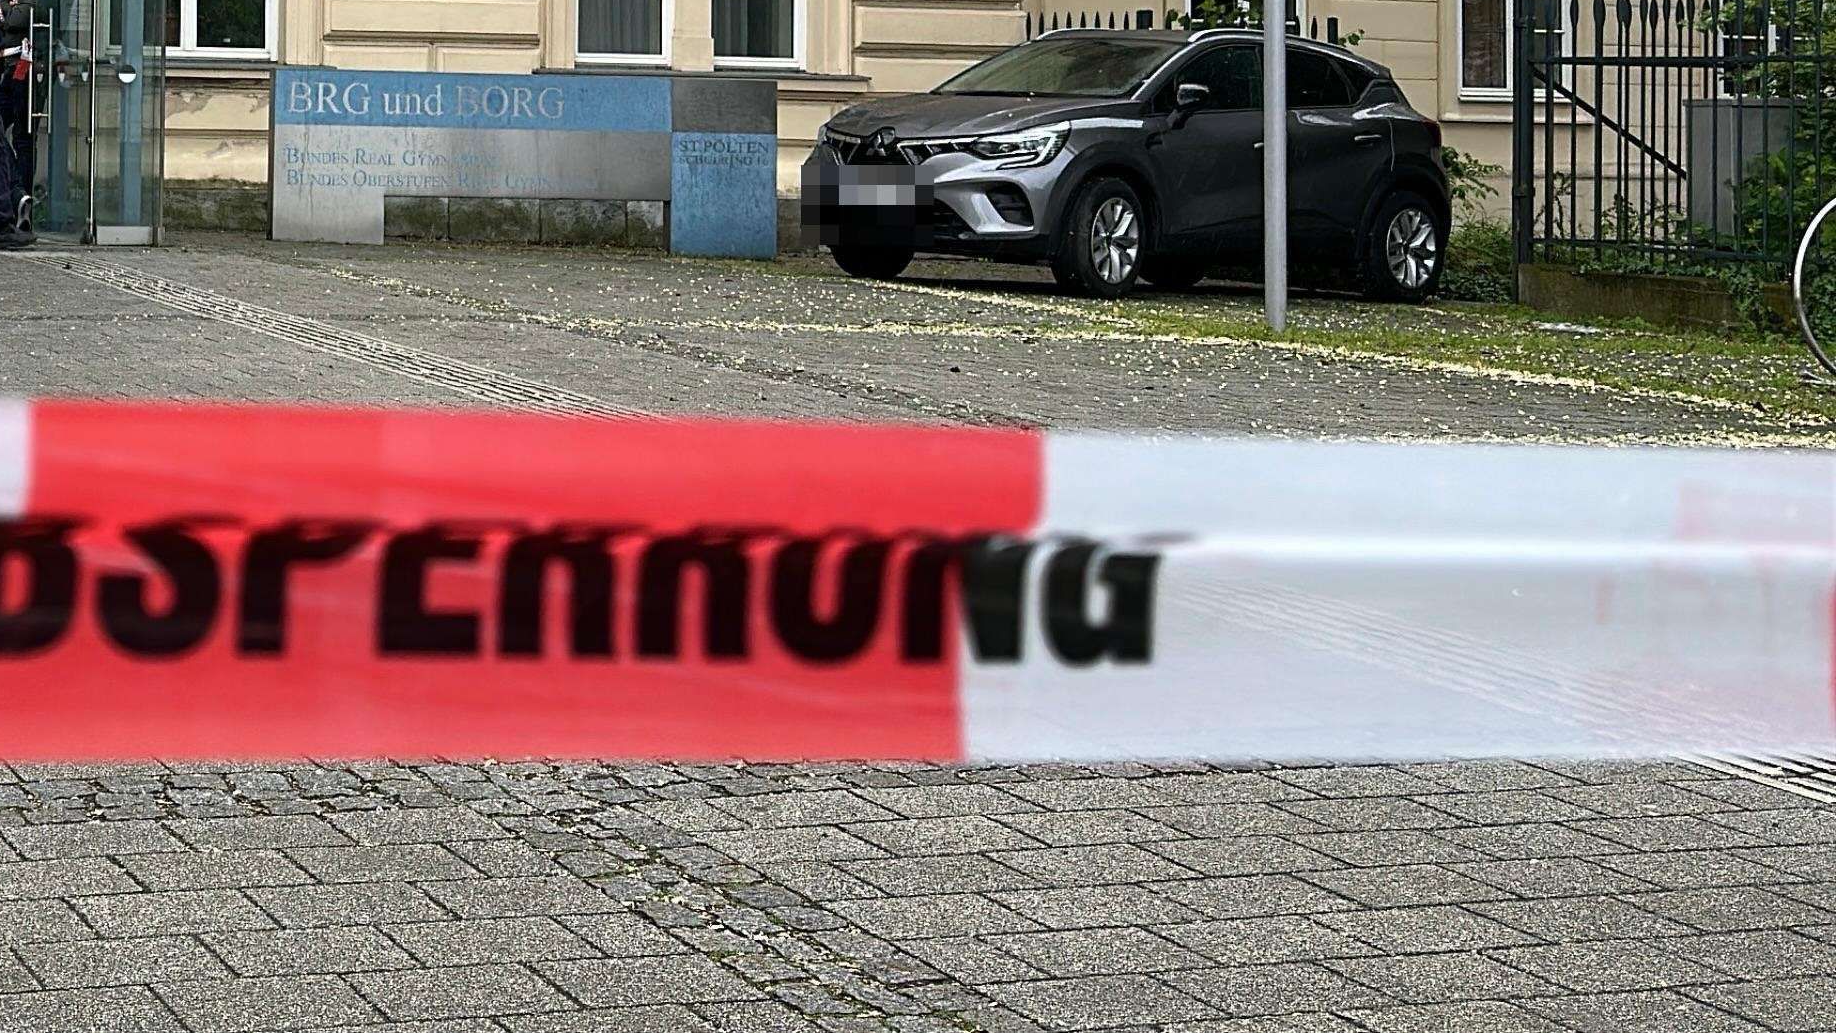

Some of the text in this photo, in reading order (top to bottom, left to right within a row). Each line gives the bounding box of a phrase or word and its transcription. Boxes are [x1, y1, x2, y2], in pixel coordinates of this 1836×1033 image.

[288, 81, 564, 119] BRG und BORG
